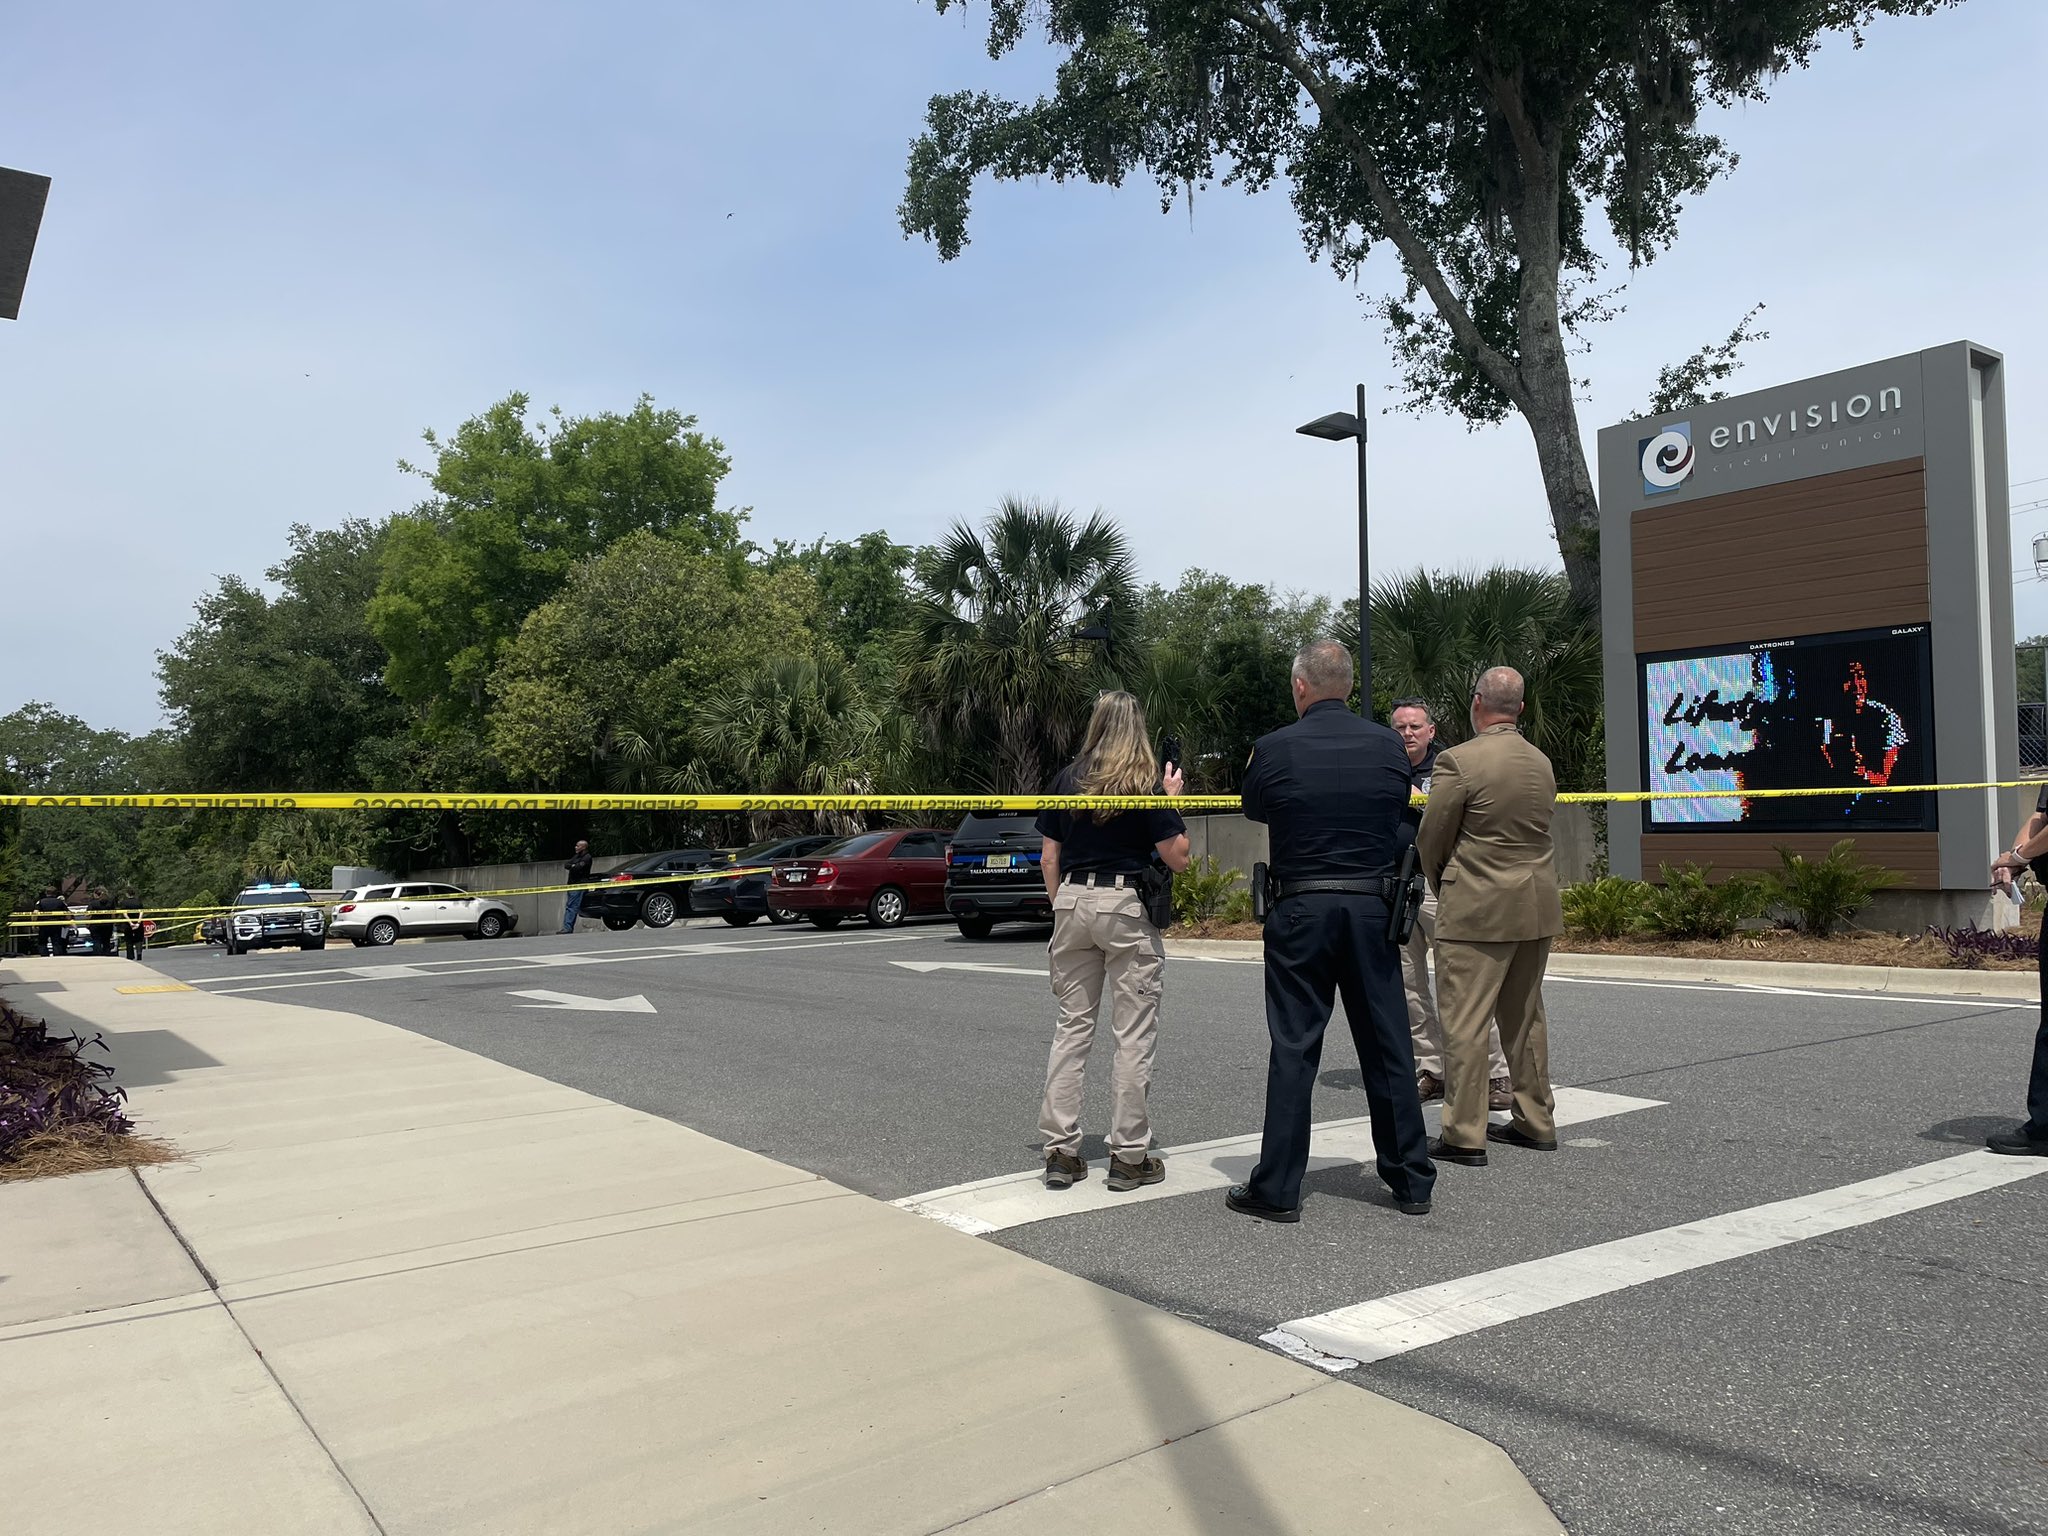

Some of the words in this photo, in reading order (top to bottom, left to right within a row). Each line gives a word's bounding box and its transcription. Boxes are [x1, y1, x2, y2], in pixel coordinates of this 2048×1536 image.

[1710, 386, 1902, 449] envision
[1820, 427, 1902, 452] union
[1749, 640, 1795, 650] DAKTRONICS
